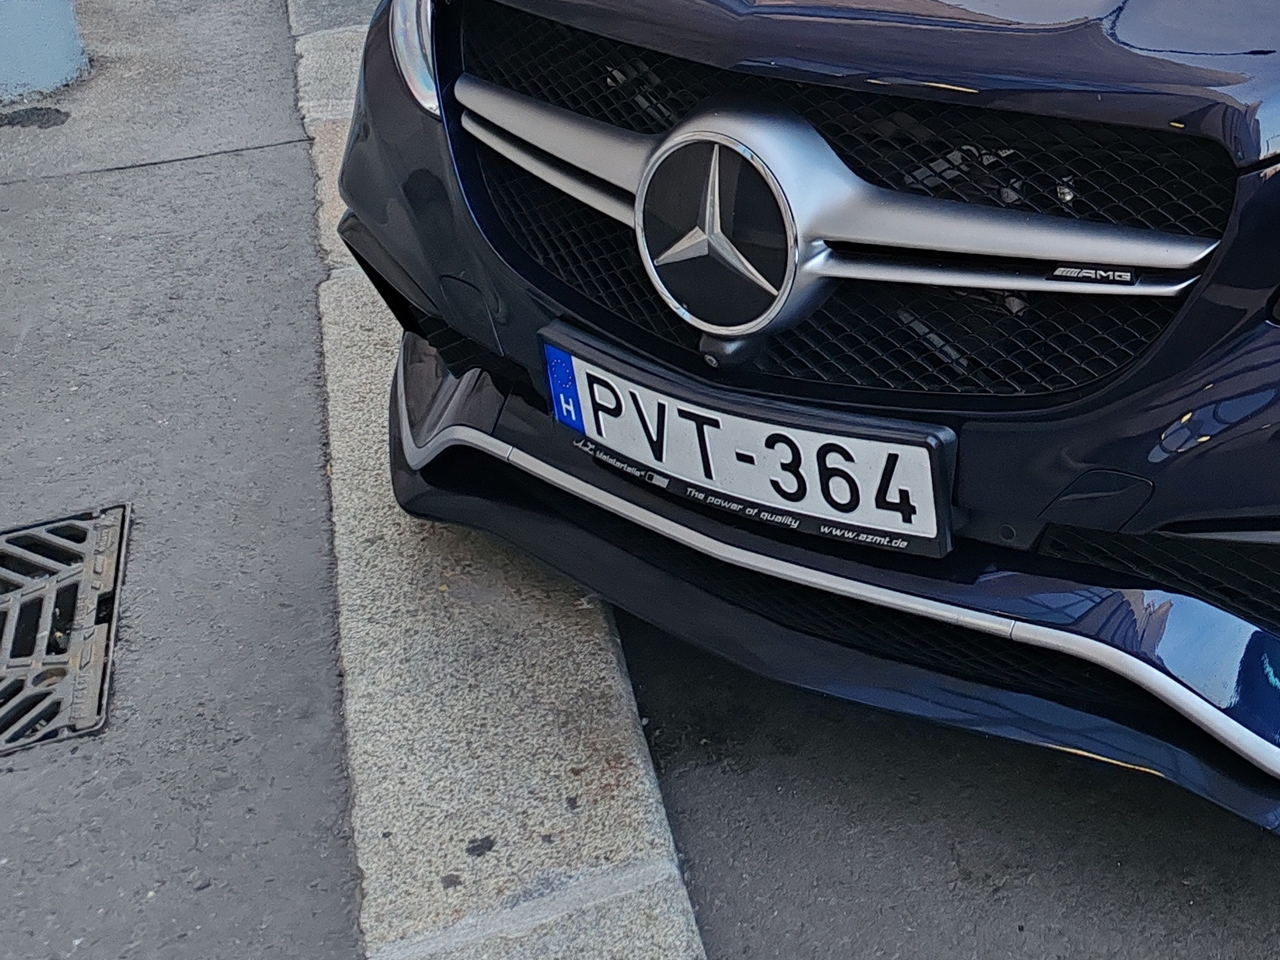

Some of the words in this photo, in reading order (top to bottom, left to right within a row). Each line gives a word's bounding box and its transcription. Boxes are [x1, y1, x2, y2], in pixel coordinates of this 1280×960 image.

[1078, 269, 1131, 281] AMG
[560, 393, 576, 421] H
[586, 369, 917, 525] PVT-364
[686, 487, 705, 500] The
[706, 495, 743, 512] power
[745, 506, 758, 517] of
[760, 510, 800, 529] quality
[820, 523, 909, 549] www.azmt.de
